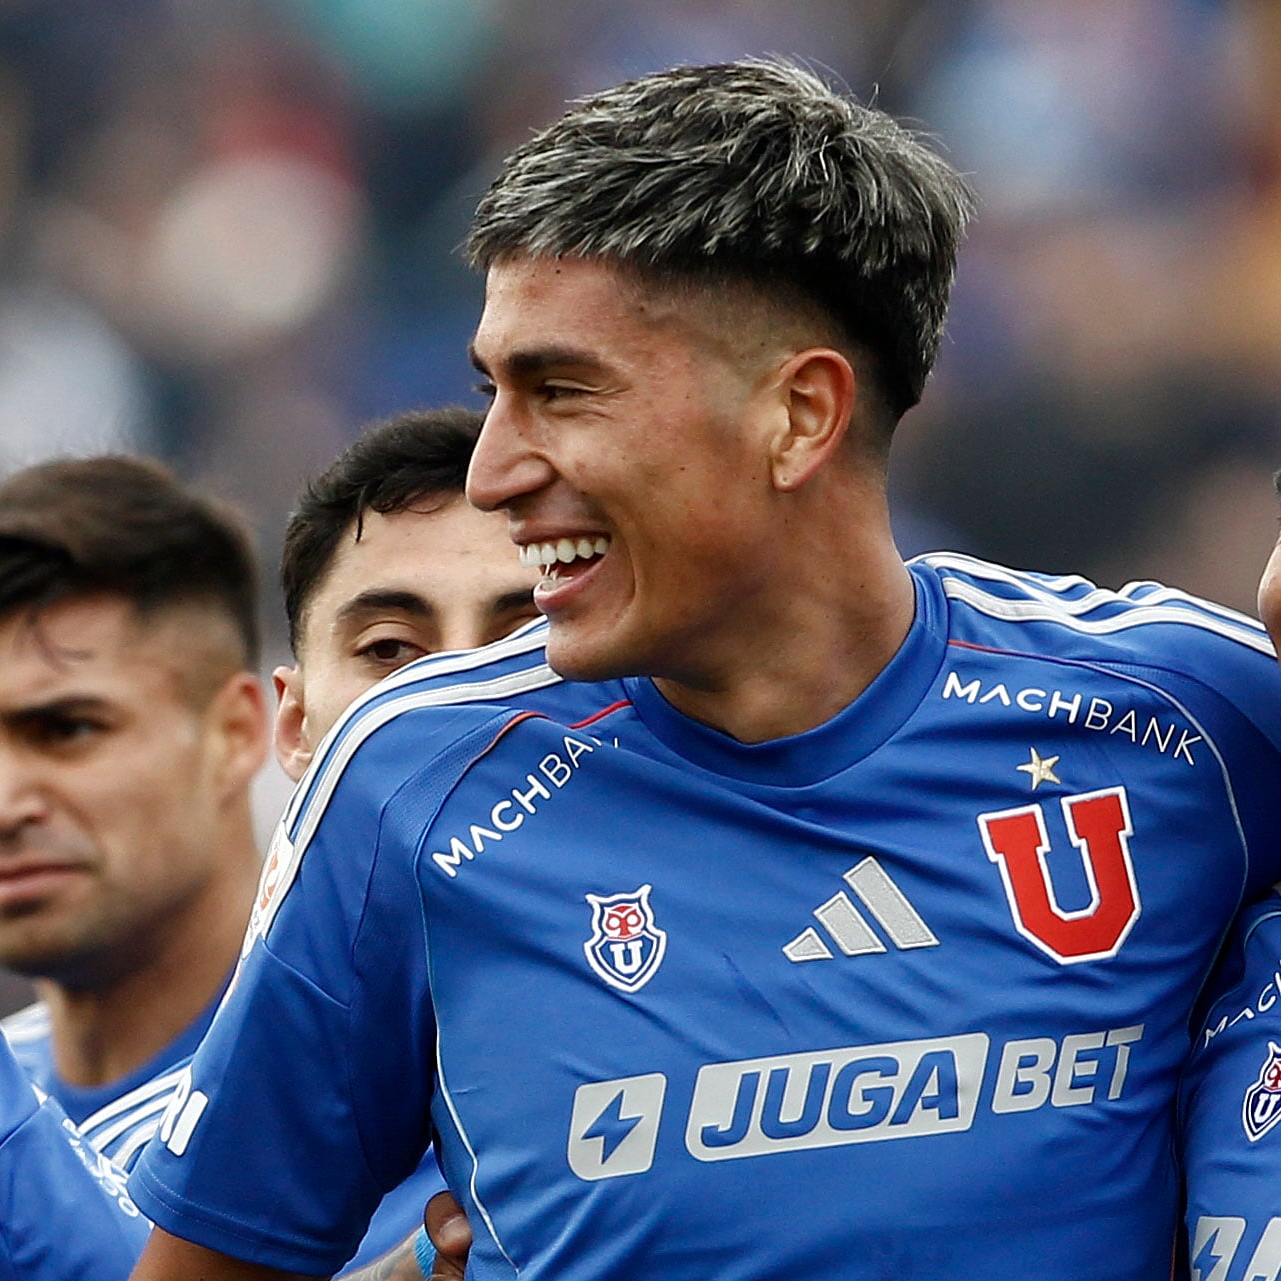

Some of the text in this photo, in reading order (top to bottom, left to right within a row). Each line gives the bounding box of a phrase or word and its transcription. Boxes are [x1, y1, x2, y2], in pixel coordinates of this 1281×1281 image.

[942, 670, 1203, 767] MACHBANK
[432, 735, 619, 878] MACHBA
[977, 785, 1143, 966] U
